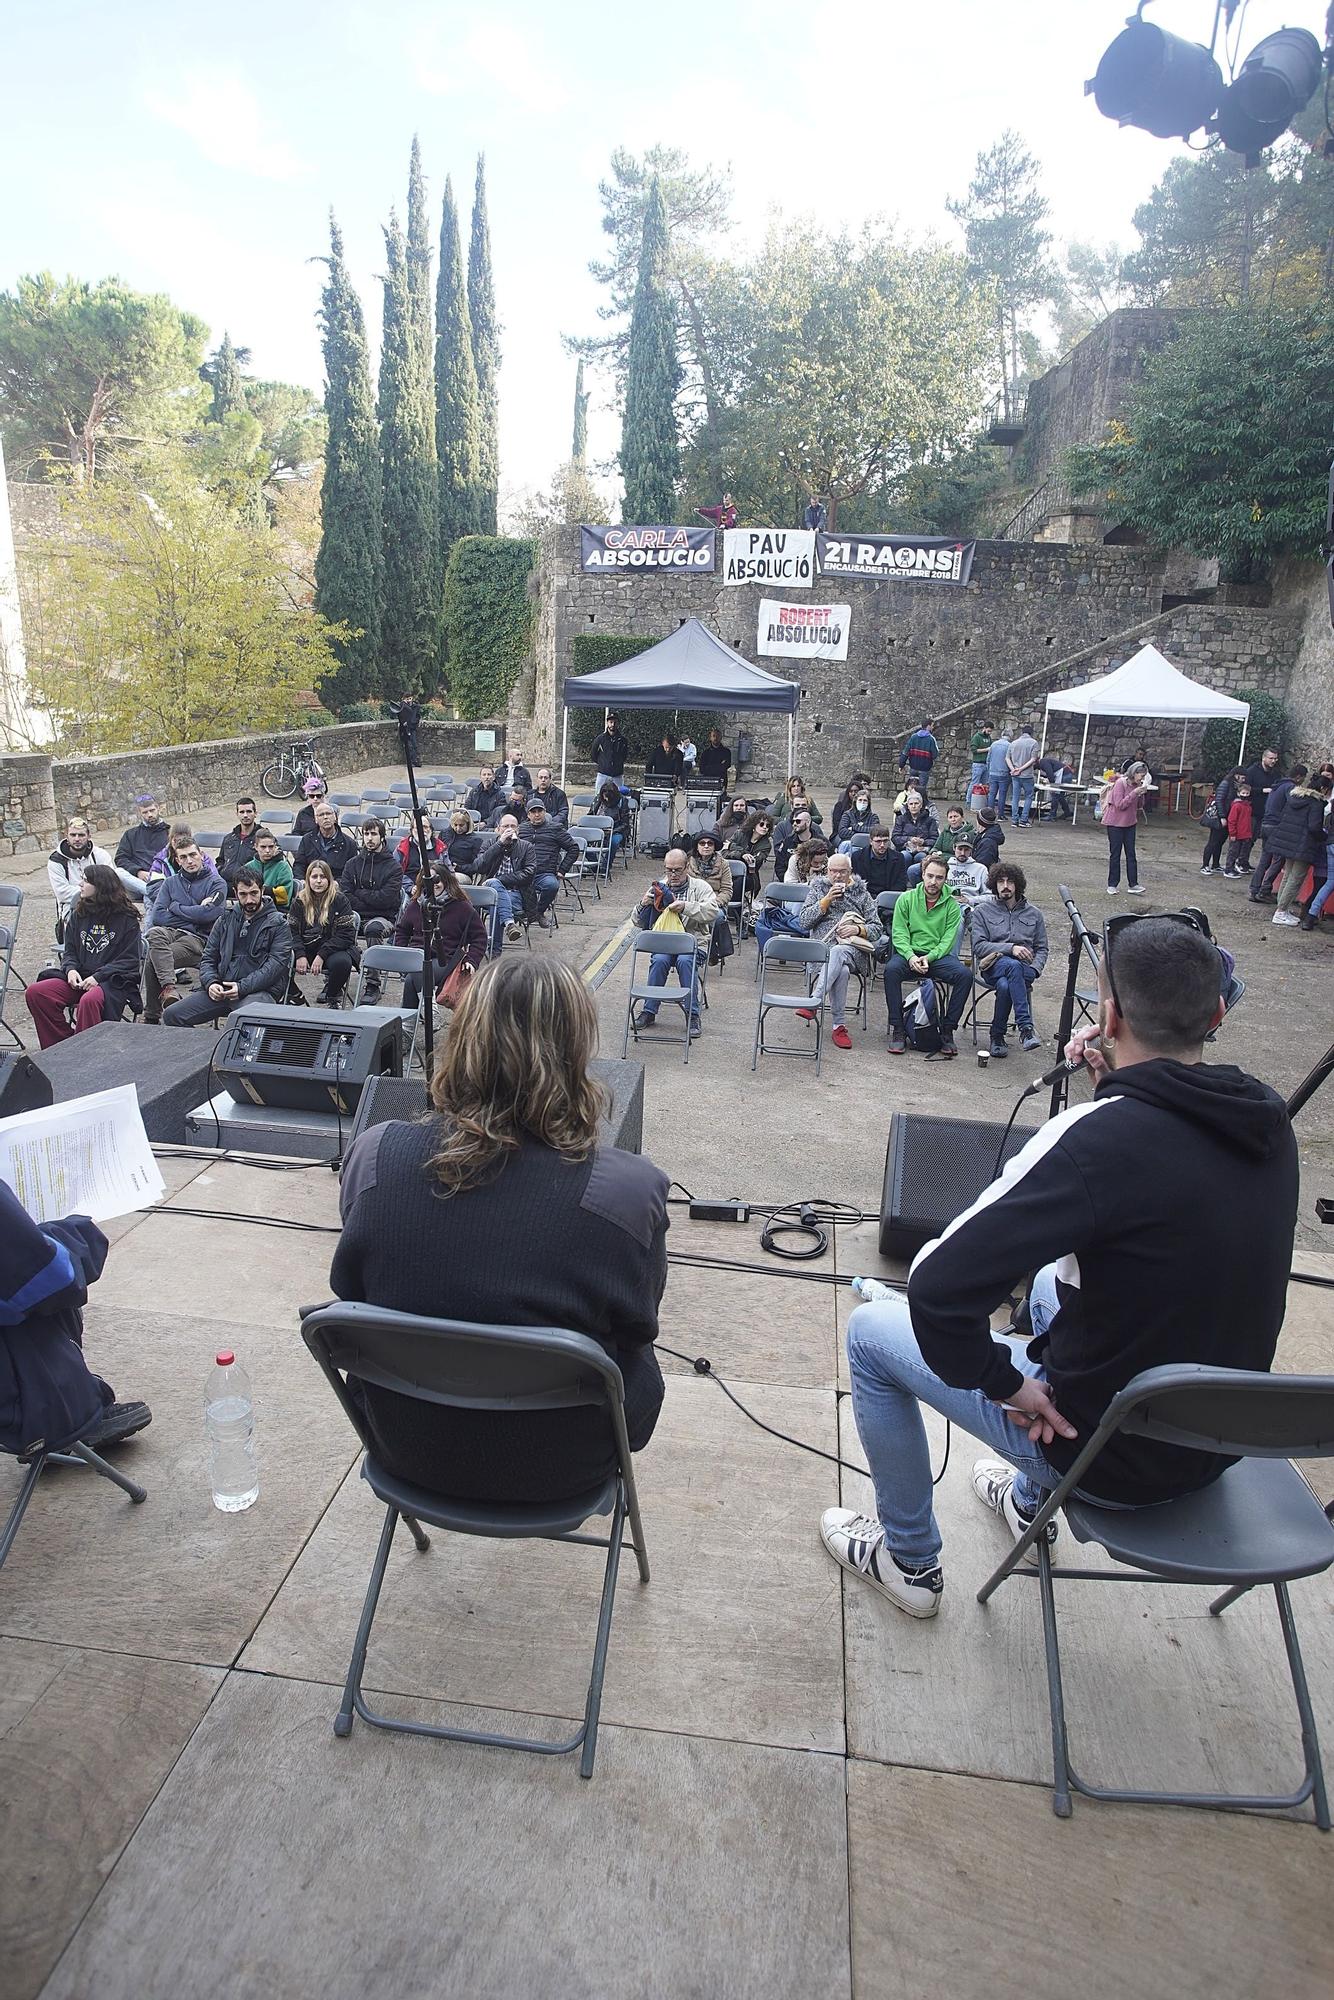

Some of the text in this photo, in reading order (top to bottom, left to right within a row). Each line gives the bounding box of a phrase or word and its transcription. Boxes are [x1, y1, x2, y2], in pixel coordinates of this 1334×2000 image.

[604, 529, 690, 549] CARLA
[749, 533, 787, 555] PAU
[585, 544, 711, 566] ABSOLUCIÓ
[824, 541, 851, 563] 21
[824, 562, 951, 579] ENCAUSADES 1 OCTUBRE 2018
[779, 607, 832, 626] ROBERT
[767, 623, 842, 645] ABSOLUCIÓ
